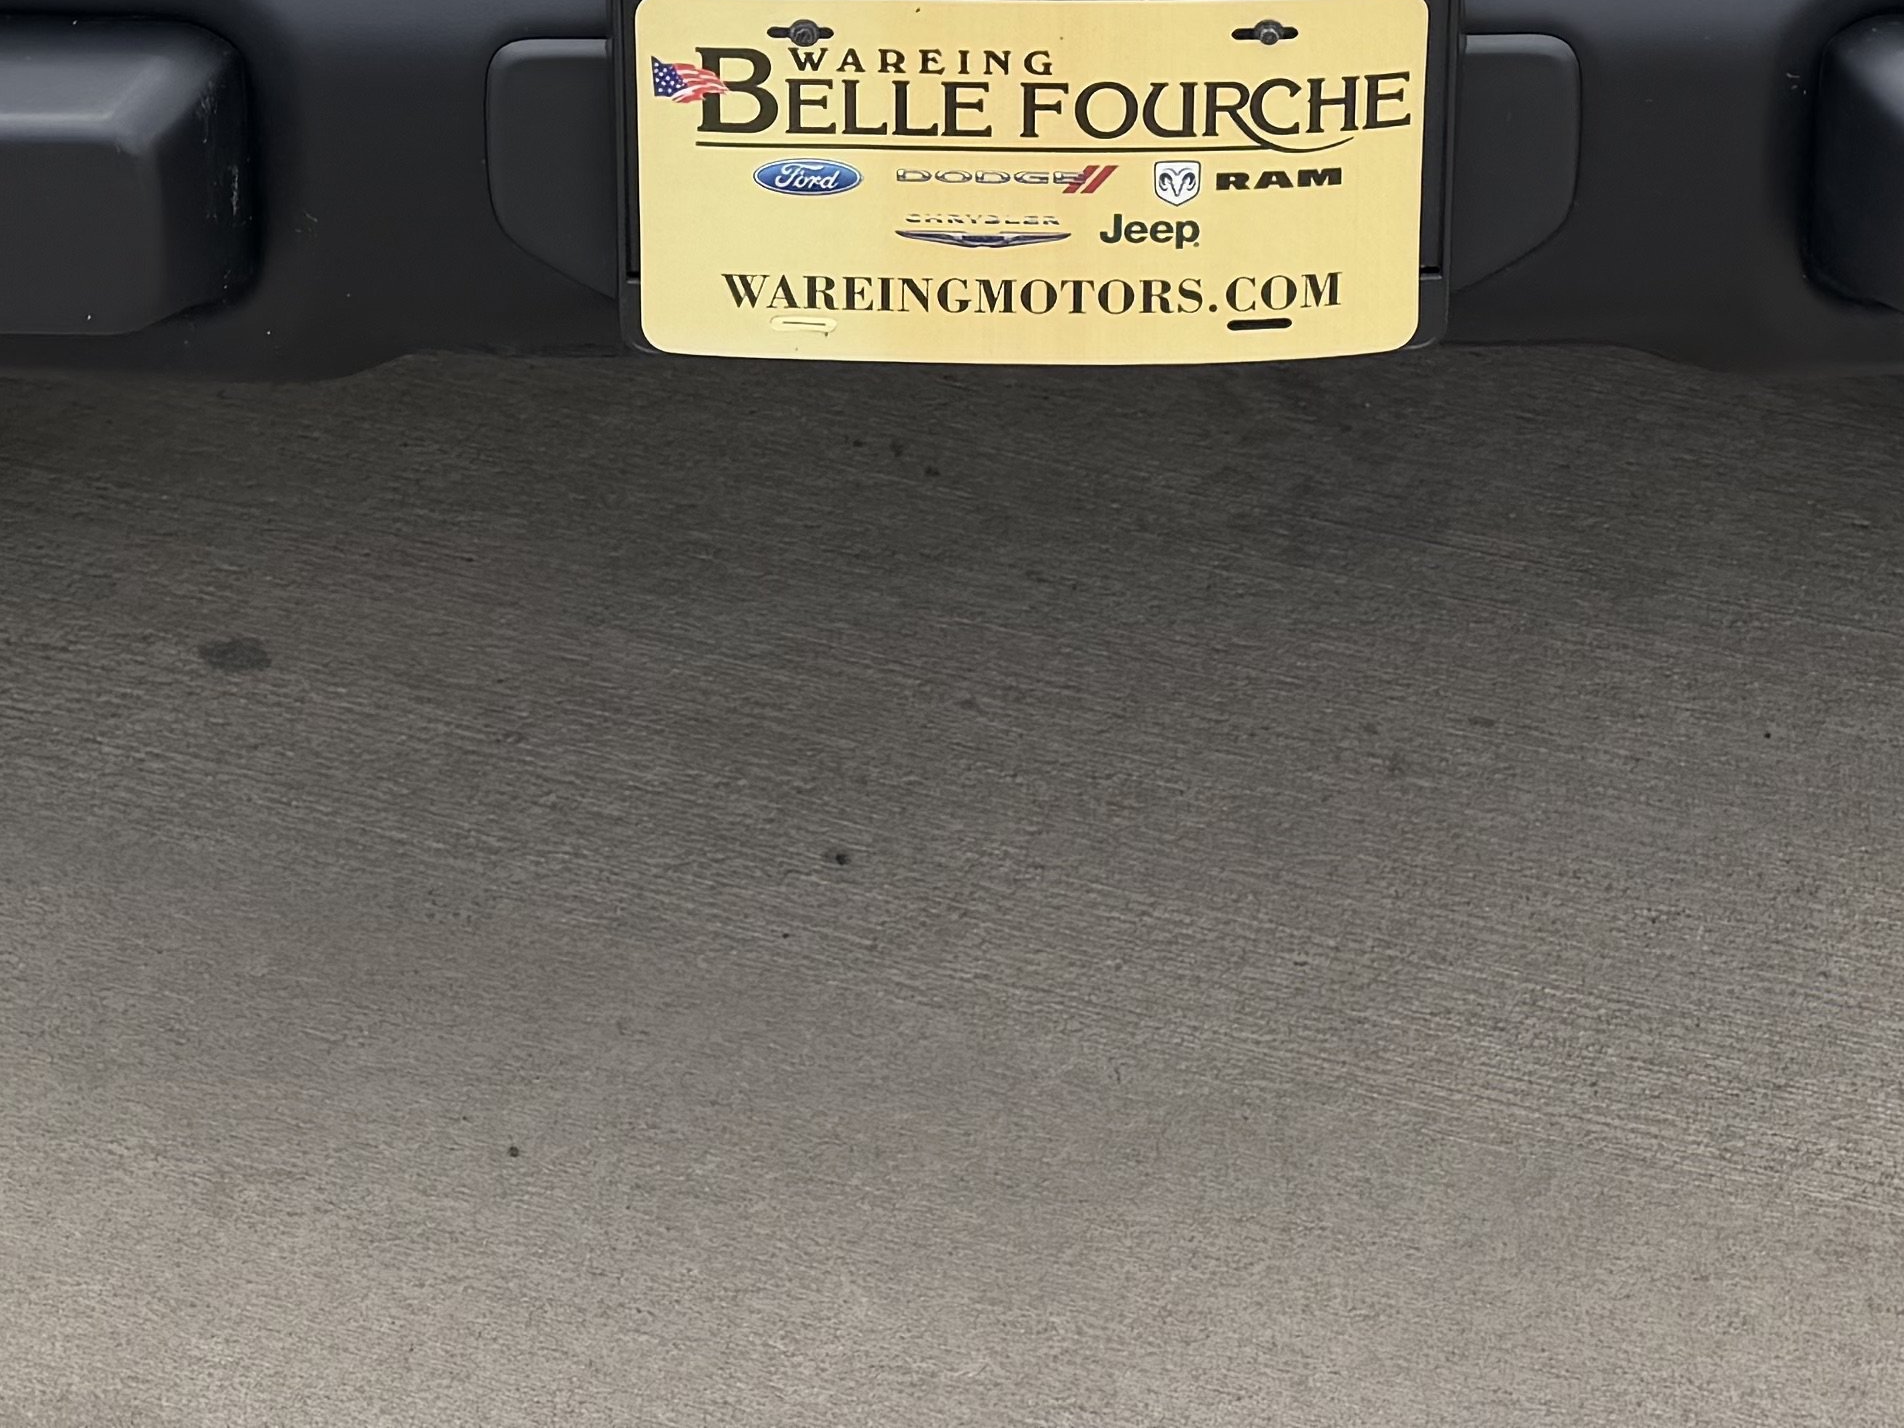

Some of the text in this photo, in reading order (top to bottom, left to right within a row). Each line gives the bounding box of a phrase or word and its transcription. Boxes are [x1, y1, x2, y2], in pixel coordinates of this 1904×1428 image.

[787, 47, 1053, 76] WAREING
[695, 46, 1411, 153] BELLE FOURCHE
[774, 162, 841, 191] Ford
[896, 168, 1088, 185] DODGE
[1216, 166, 1343, 191] RAM
[905, 212, 1061, 226] CHRYSLER
[1099, 213, 1201, 250] Jeep
[721, 270, 1344, 315] WAREINGMOTORS.COM
